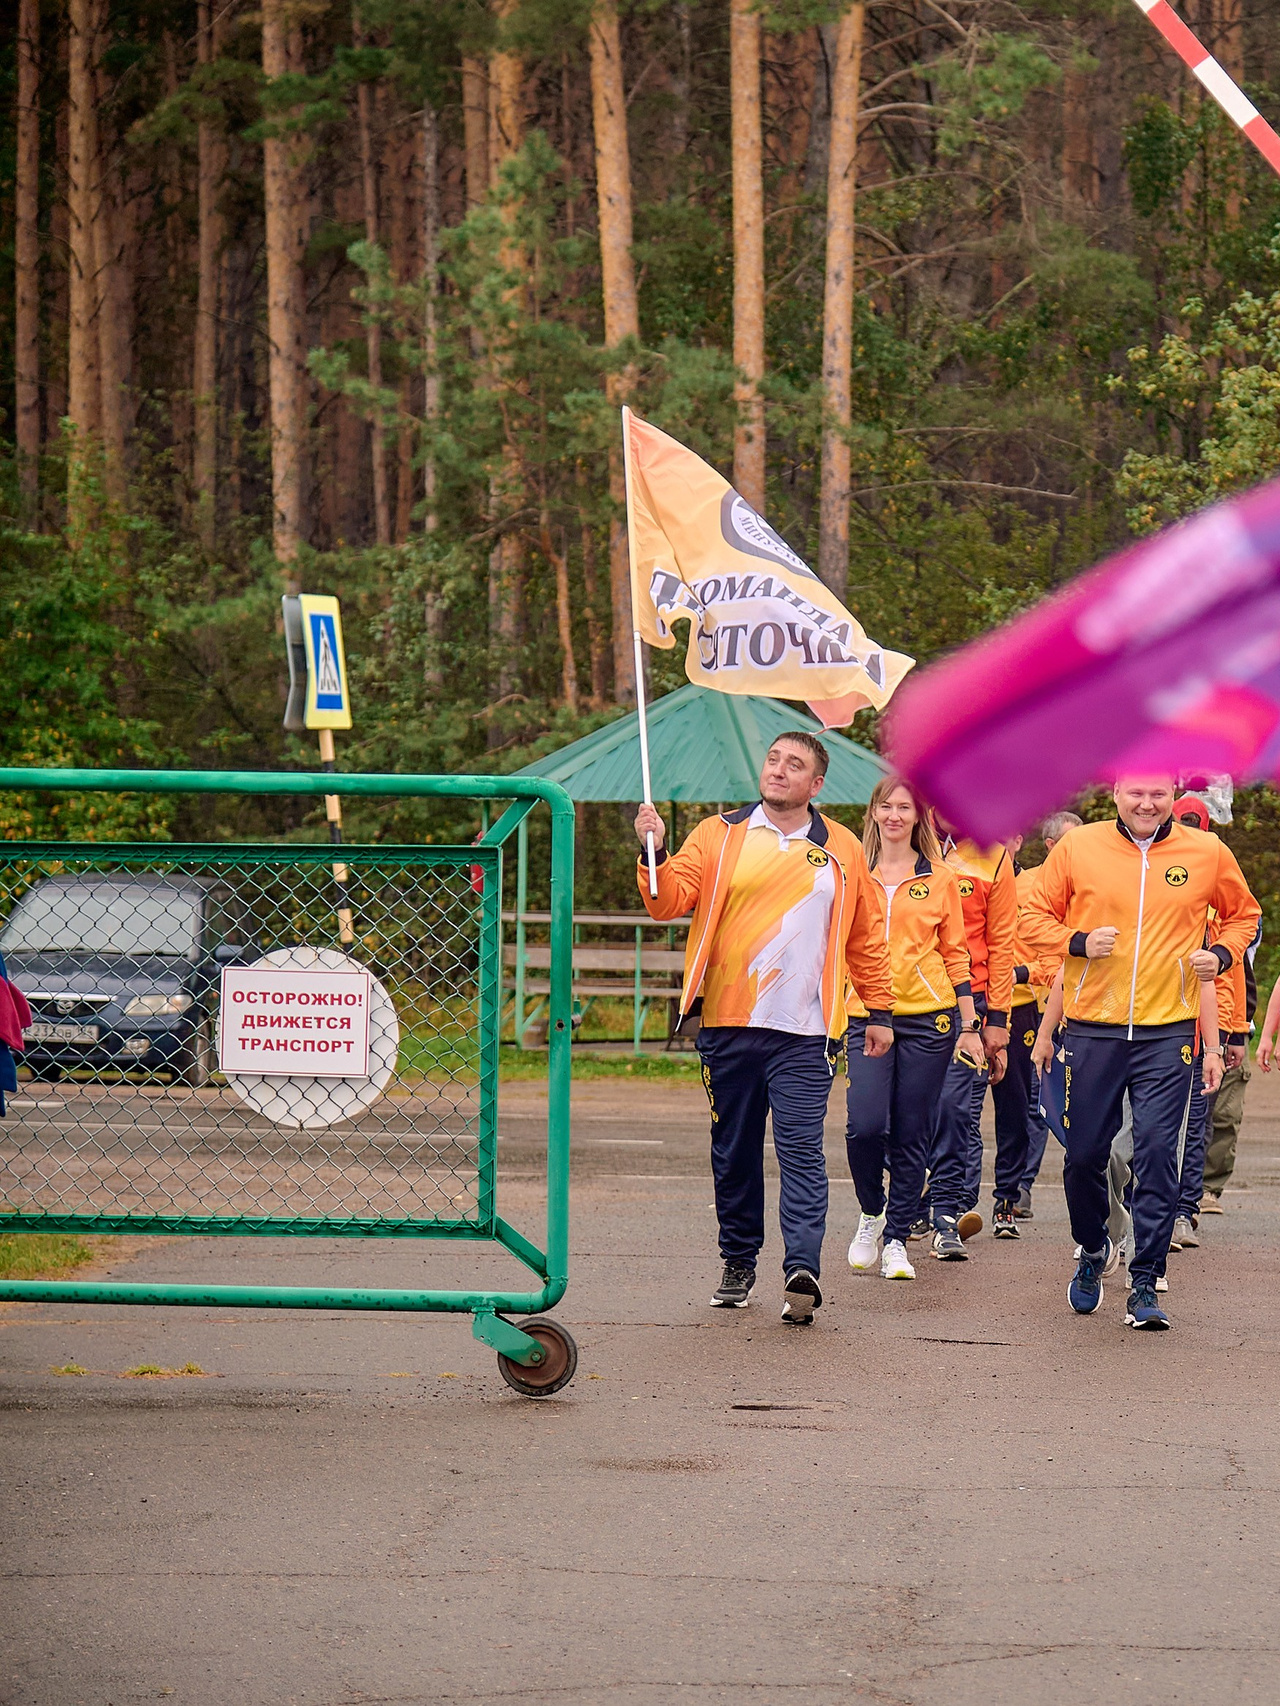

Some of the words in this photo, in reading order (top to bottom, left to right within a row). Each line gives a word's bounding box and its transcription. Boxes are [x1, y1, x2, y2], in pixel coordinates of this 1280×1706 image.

[232, 990, 363, 1007] ОСТОРОЖНО!
[241, 1014, 351, 1030] ДВИЖЕТСЯ
[238, 1037, 355, 1053] ТРАНСПОРТ
